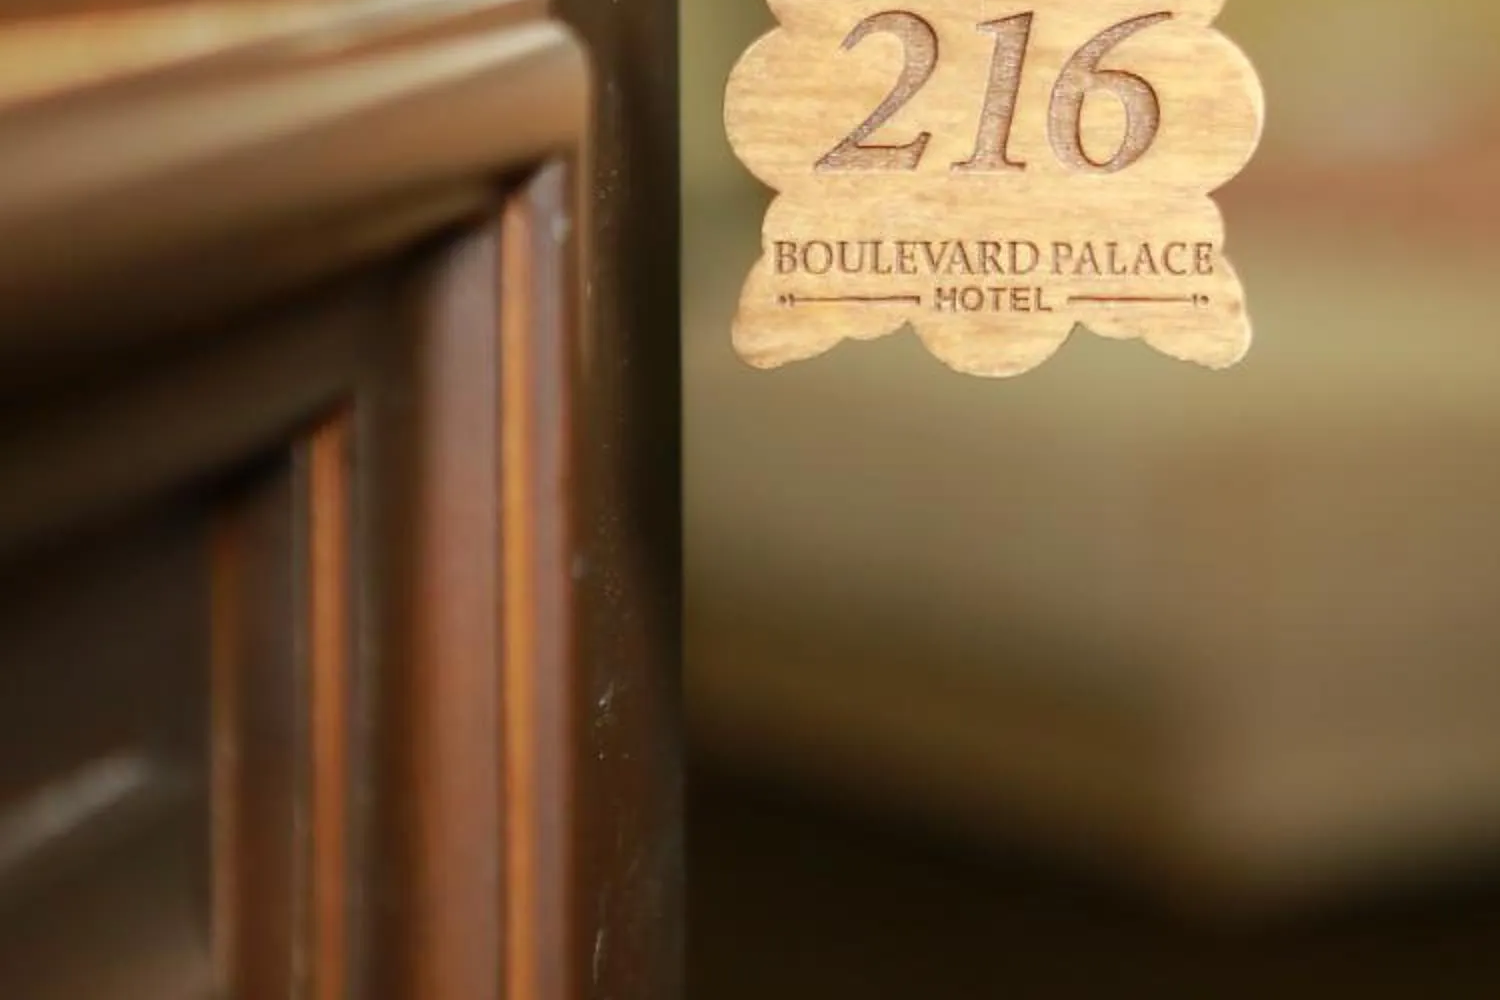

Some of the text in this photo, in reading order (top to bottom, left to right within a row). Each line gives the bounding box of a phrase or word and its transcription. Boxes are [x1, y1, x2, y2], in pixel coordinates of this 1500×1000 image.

[814, 10, 1173, 173] 216
[774, 240, 1214, 277] BOULEVARD PALACE
[934, 286, 1053, 313] HOTEL
